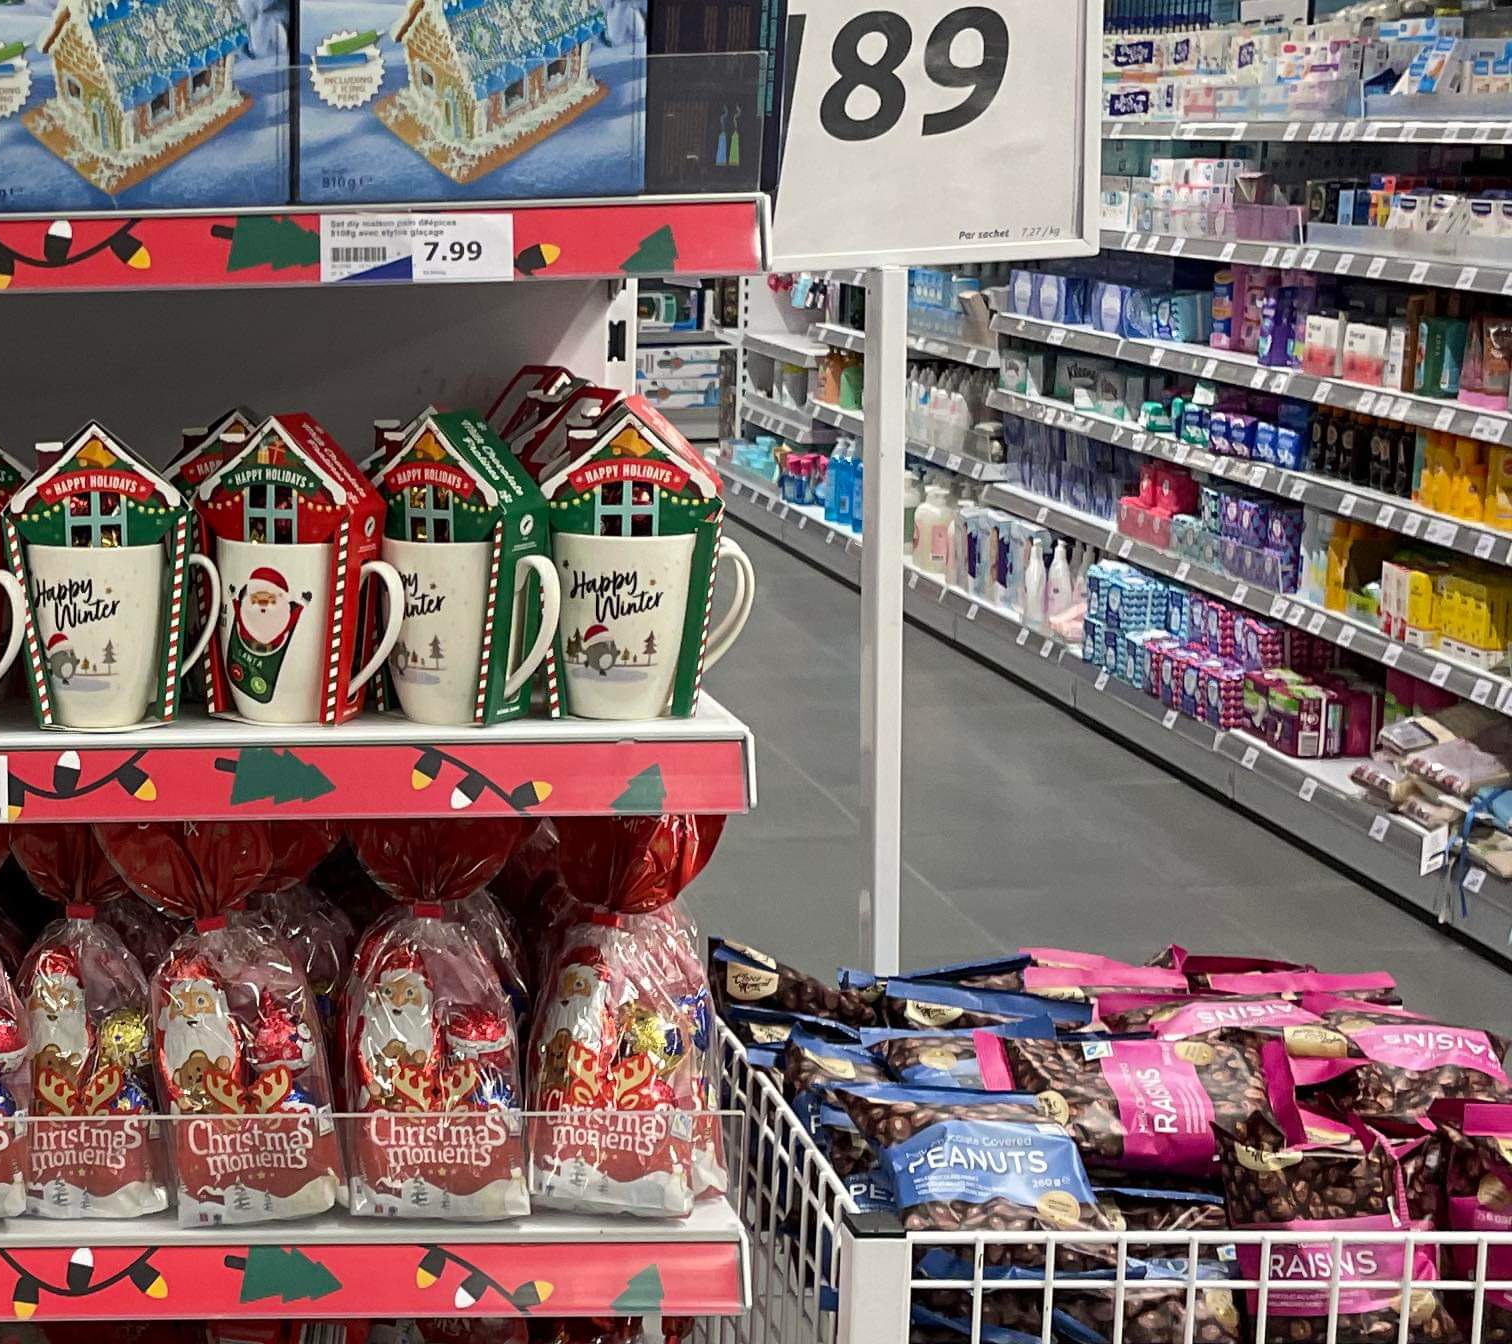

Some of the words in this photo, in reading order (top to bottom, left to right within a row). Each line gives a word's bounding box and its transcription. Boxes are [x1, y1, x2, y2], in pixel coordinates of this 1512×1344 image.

[958, 230, 976, 240] Par
[978, 229, 1010, 239] sachet
[423, 240, 483, 262] 7.99
[53, 476, 86, 496] HAPPY
[89, 475, 138, 494] HOLIDAYS
[234, 468, 263, 486] HAPPY
[265, 467, 307, 488] HOLIDAYS
[396, 468, 423, 486] HAPPY
[423, 467, 463, 490] HOLIDAYS
[584, 465, 618, 484] HAPPY
[621, 463, 672, 484] HOLIDAYS
[33, 575, 94, 607] Happy
[569, 568, 639, 601] Happy
[53, 596, 123, 633] Winter
[402, 594, 447, 618] inter
[594, 589, 666, 624] Winter
[1195, 1003, 1293, 1025] AISINS
[30, 1114, 145, 1153] hristmas
[187, 1112, 316, 1157] Christmas
[369, 1106, 510, 1151] Christmas
[982, 1135, 1032, 1147] Covered
[205, 1145, 310, 1177] moments
[386, 1140, 494, 1172] moments
[906, 1145, 1049, 1175] PEANUTS
